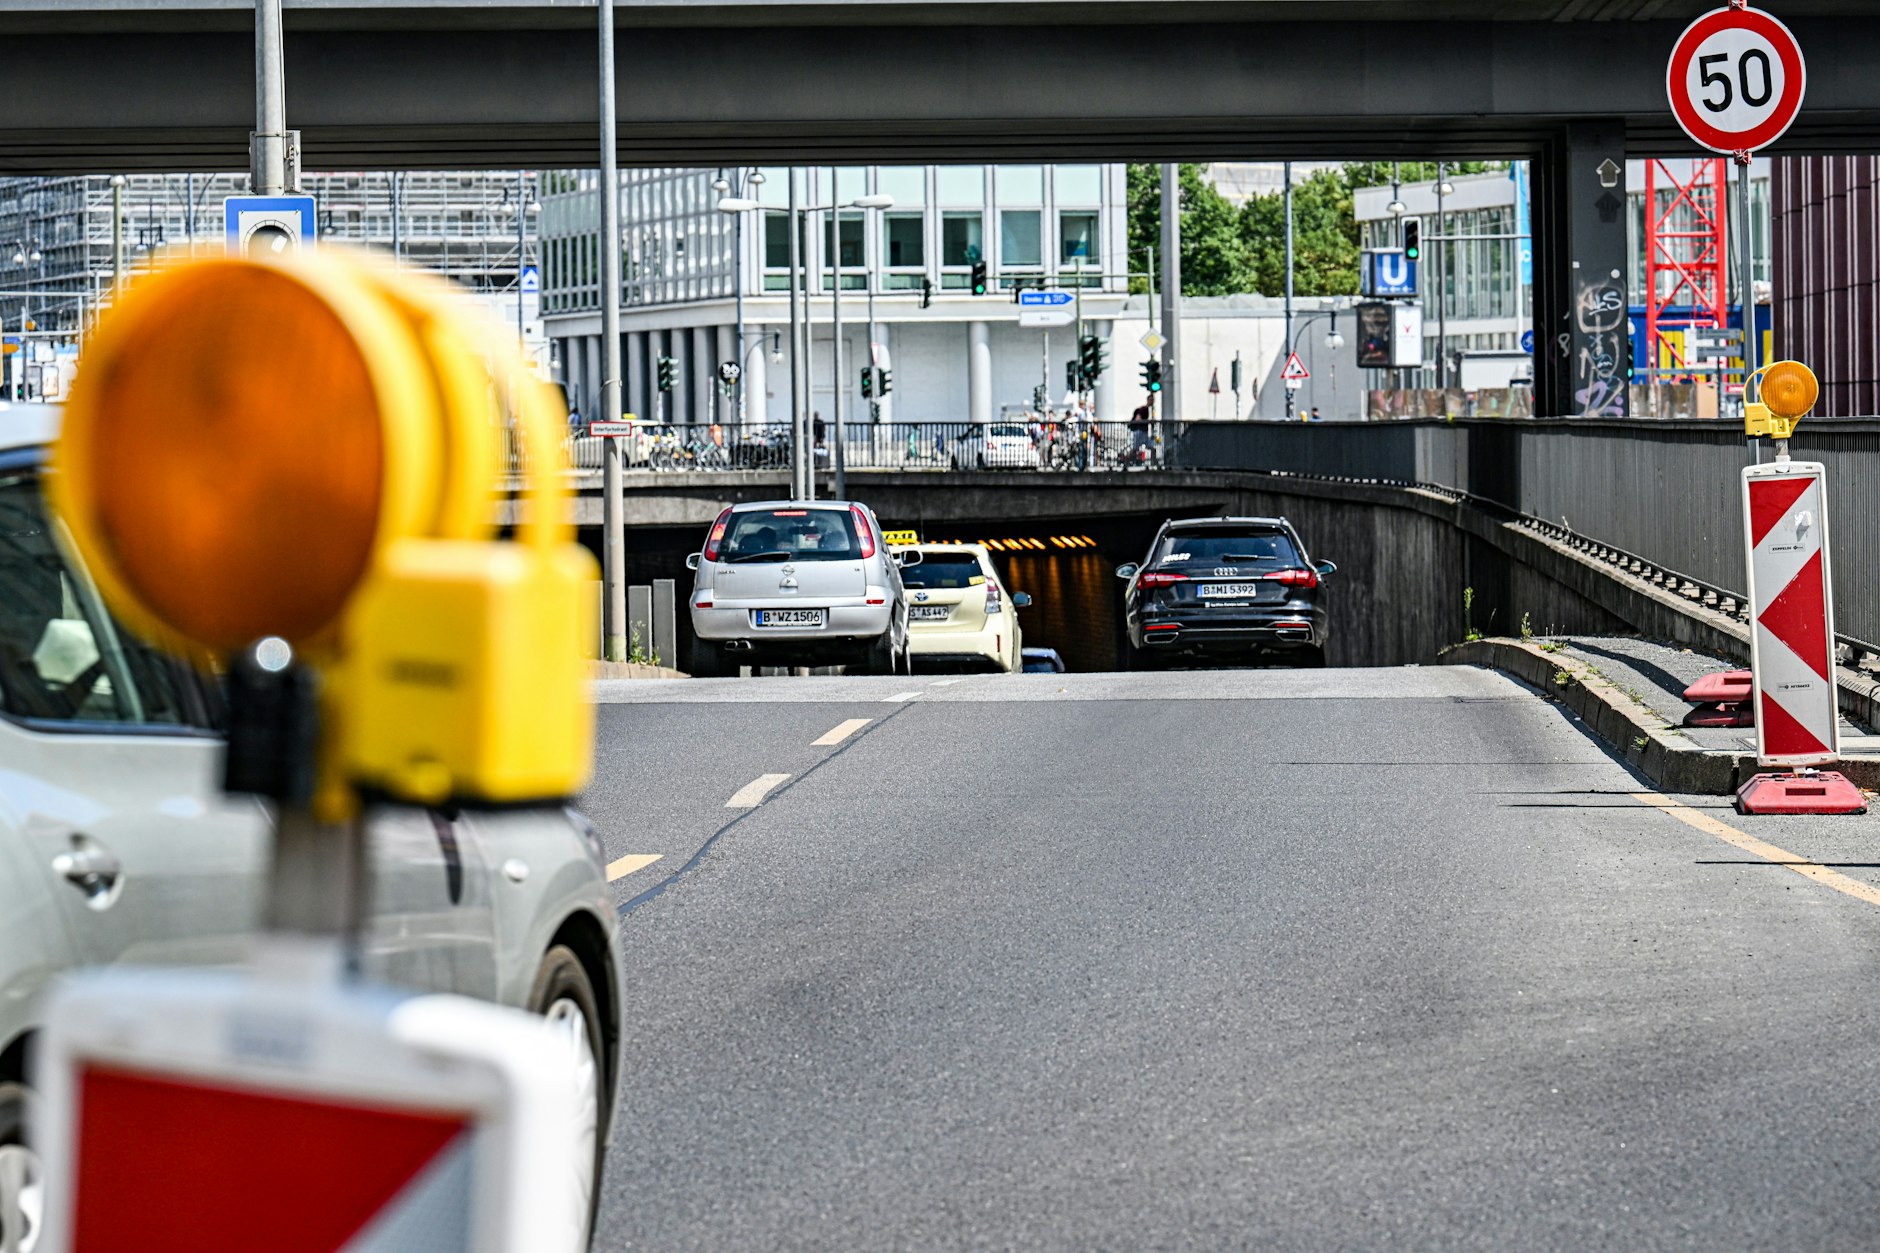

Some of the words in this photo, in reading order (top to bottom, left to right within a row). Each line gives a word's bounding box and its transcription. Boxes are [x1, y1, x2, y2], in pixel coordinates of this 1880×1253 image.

[1699, 48, 1773, 113] 50
[1382, 253, 1408, 286] U
[1203, 586, 1210, 595] B
[1216, 585, 1228, 595] MI
[1230, 585, 1254, 595] 5392
[763, 612, 771, 622] B
[777, 612, 792, 622] WZ
[793, 611, 820, 622] 1506
